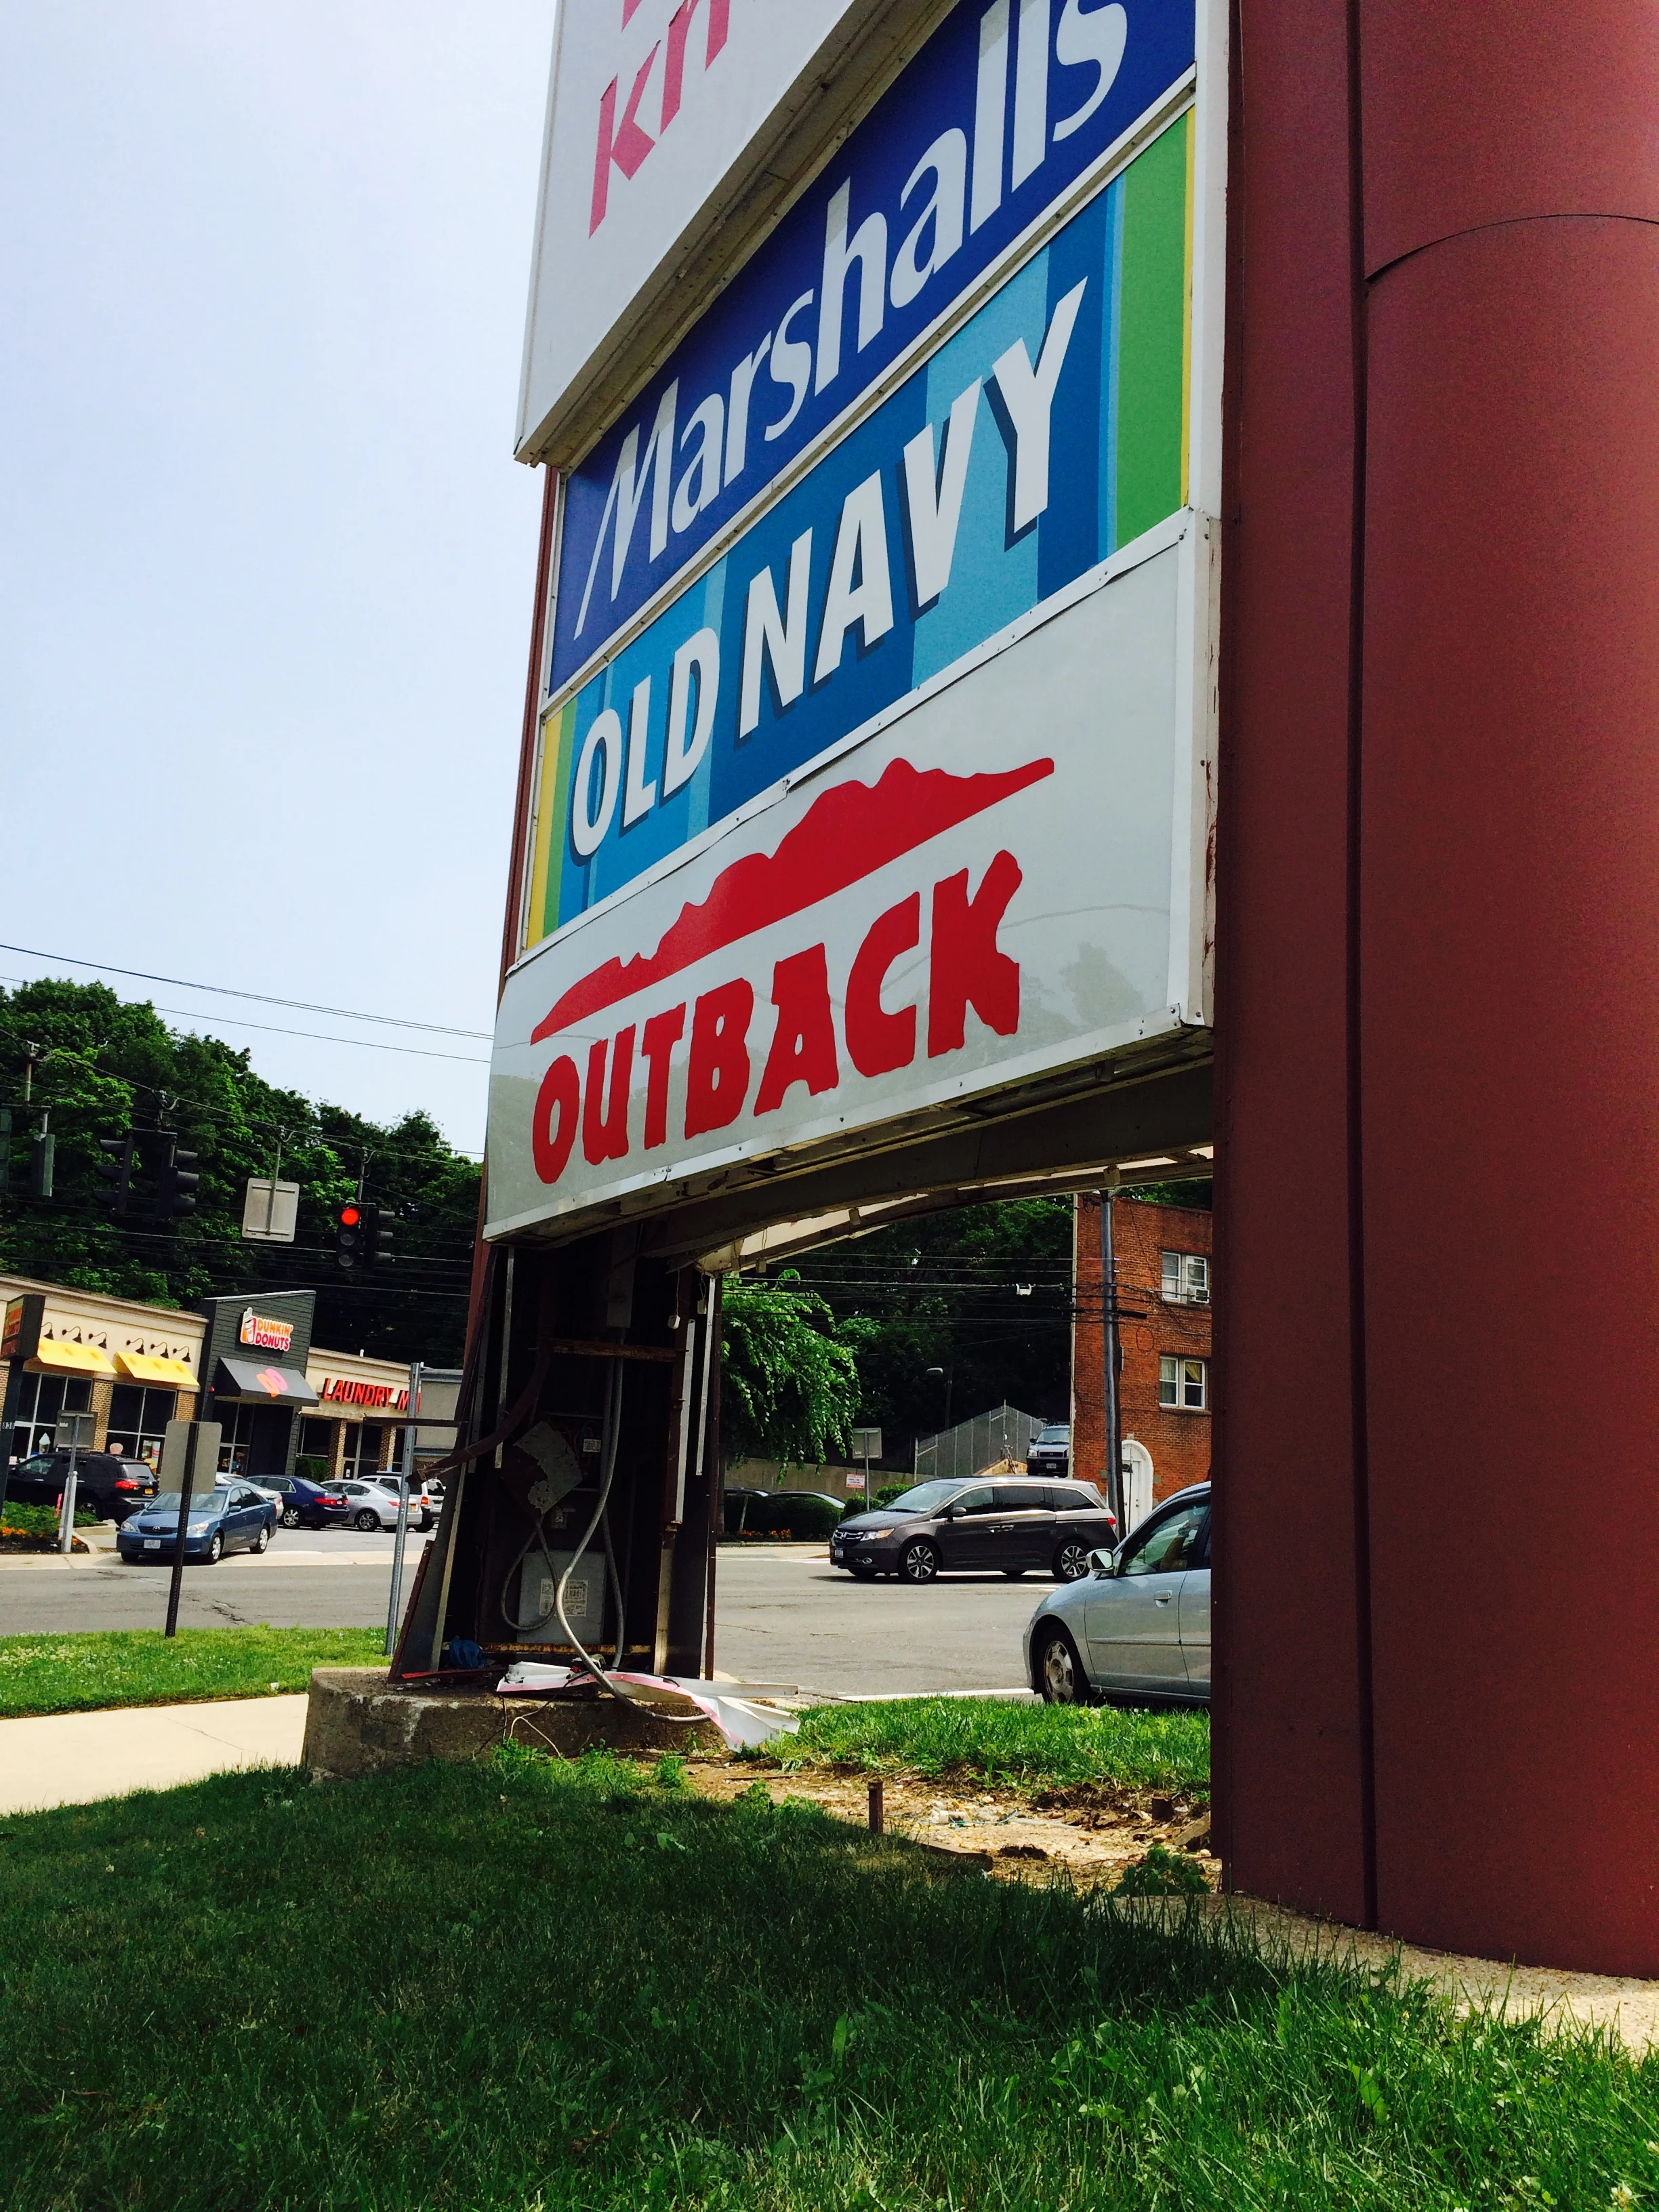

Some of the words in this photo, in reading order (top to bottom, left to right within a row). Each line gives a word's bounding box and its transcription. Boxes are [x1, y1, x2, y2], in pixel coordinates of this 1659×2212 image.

[573, 0, 1127, 641] Marshalls
[571, 627, 720, 857] OLD
[739, 275, 1088, 739] NAVY
[532, 849, 1023, 1184] OUTBACK
[255, 1332, 289, 1350] DONUTS
[321, 1378, 394, 1408] LAUNDRY
